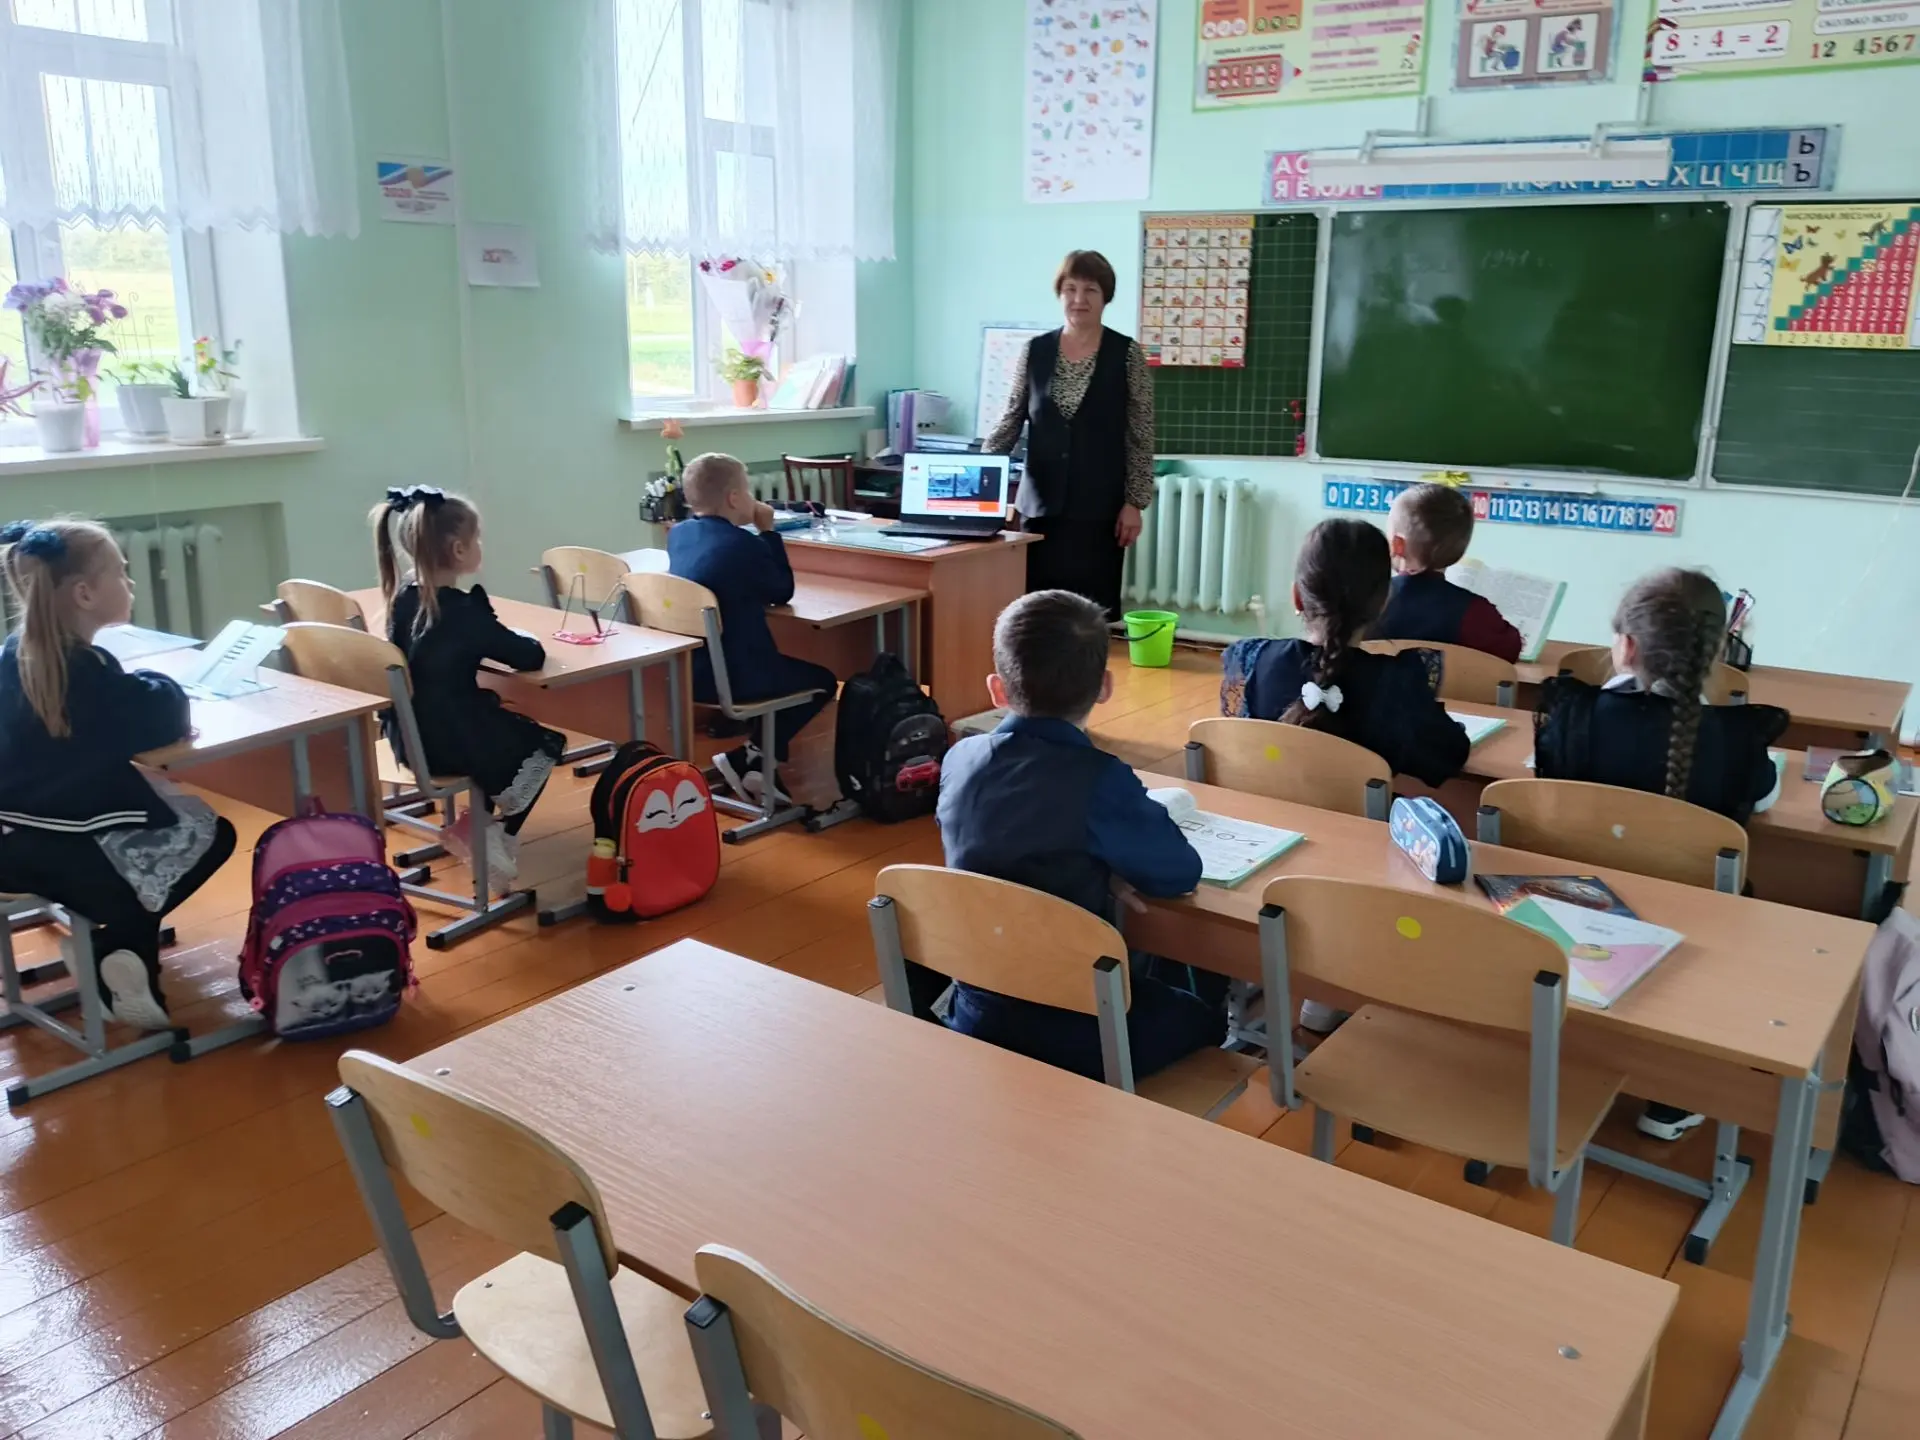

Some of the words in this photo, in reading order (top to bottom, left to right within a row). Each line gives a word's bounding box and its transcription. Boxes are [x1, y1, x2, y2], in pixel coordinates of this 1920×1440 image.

[1665, 33, 1680, 51] 8
[1711, 29, 1724, 48] 4
[1764, 25, 1779, 44] 2
[1275, 156, 1293, 174] А
[1670, 166, 1689, 186] Х
[1701, 165, 1721, 187] Ц
[1731, 164, 1749, 184] Ч
[1757, 163, 1784, 187] Щ
[1793, 163, 1811, 182] Ъ
[1274, 180, 1289, 198] Я
[1328, 486, 1338, 503] 0
[1342, 487, 1350, 504] 1
[1355, 488, 1364, 506] 2
[1369, 489, 1379, 506] 3
[1472, 496, 1488, 515] 10
[1491, 498, 1505, 516] 11
[1508, 499, 1523, 518] 12
[1525, 500, 1540, 519] 13
[1543, 501, 1560, 520] 14
[1563, 503, 1579, 521] 15
[1581, 504, 1598, 523] 16
[1599, 505, 1617, 524] 17
[1618, 506, 1635, 526] 18
[1637, 508, 1654, 527] 19
[1654, 509, 1675, 528] 20
